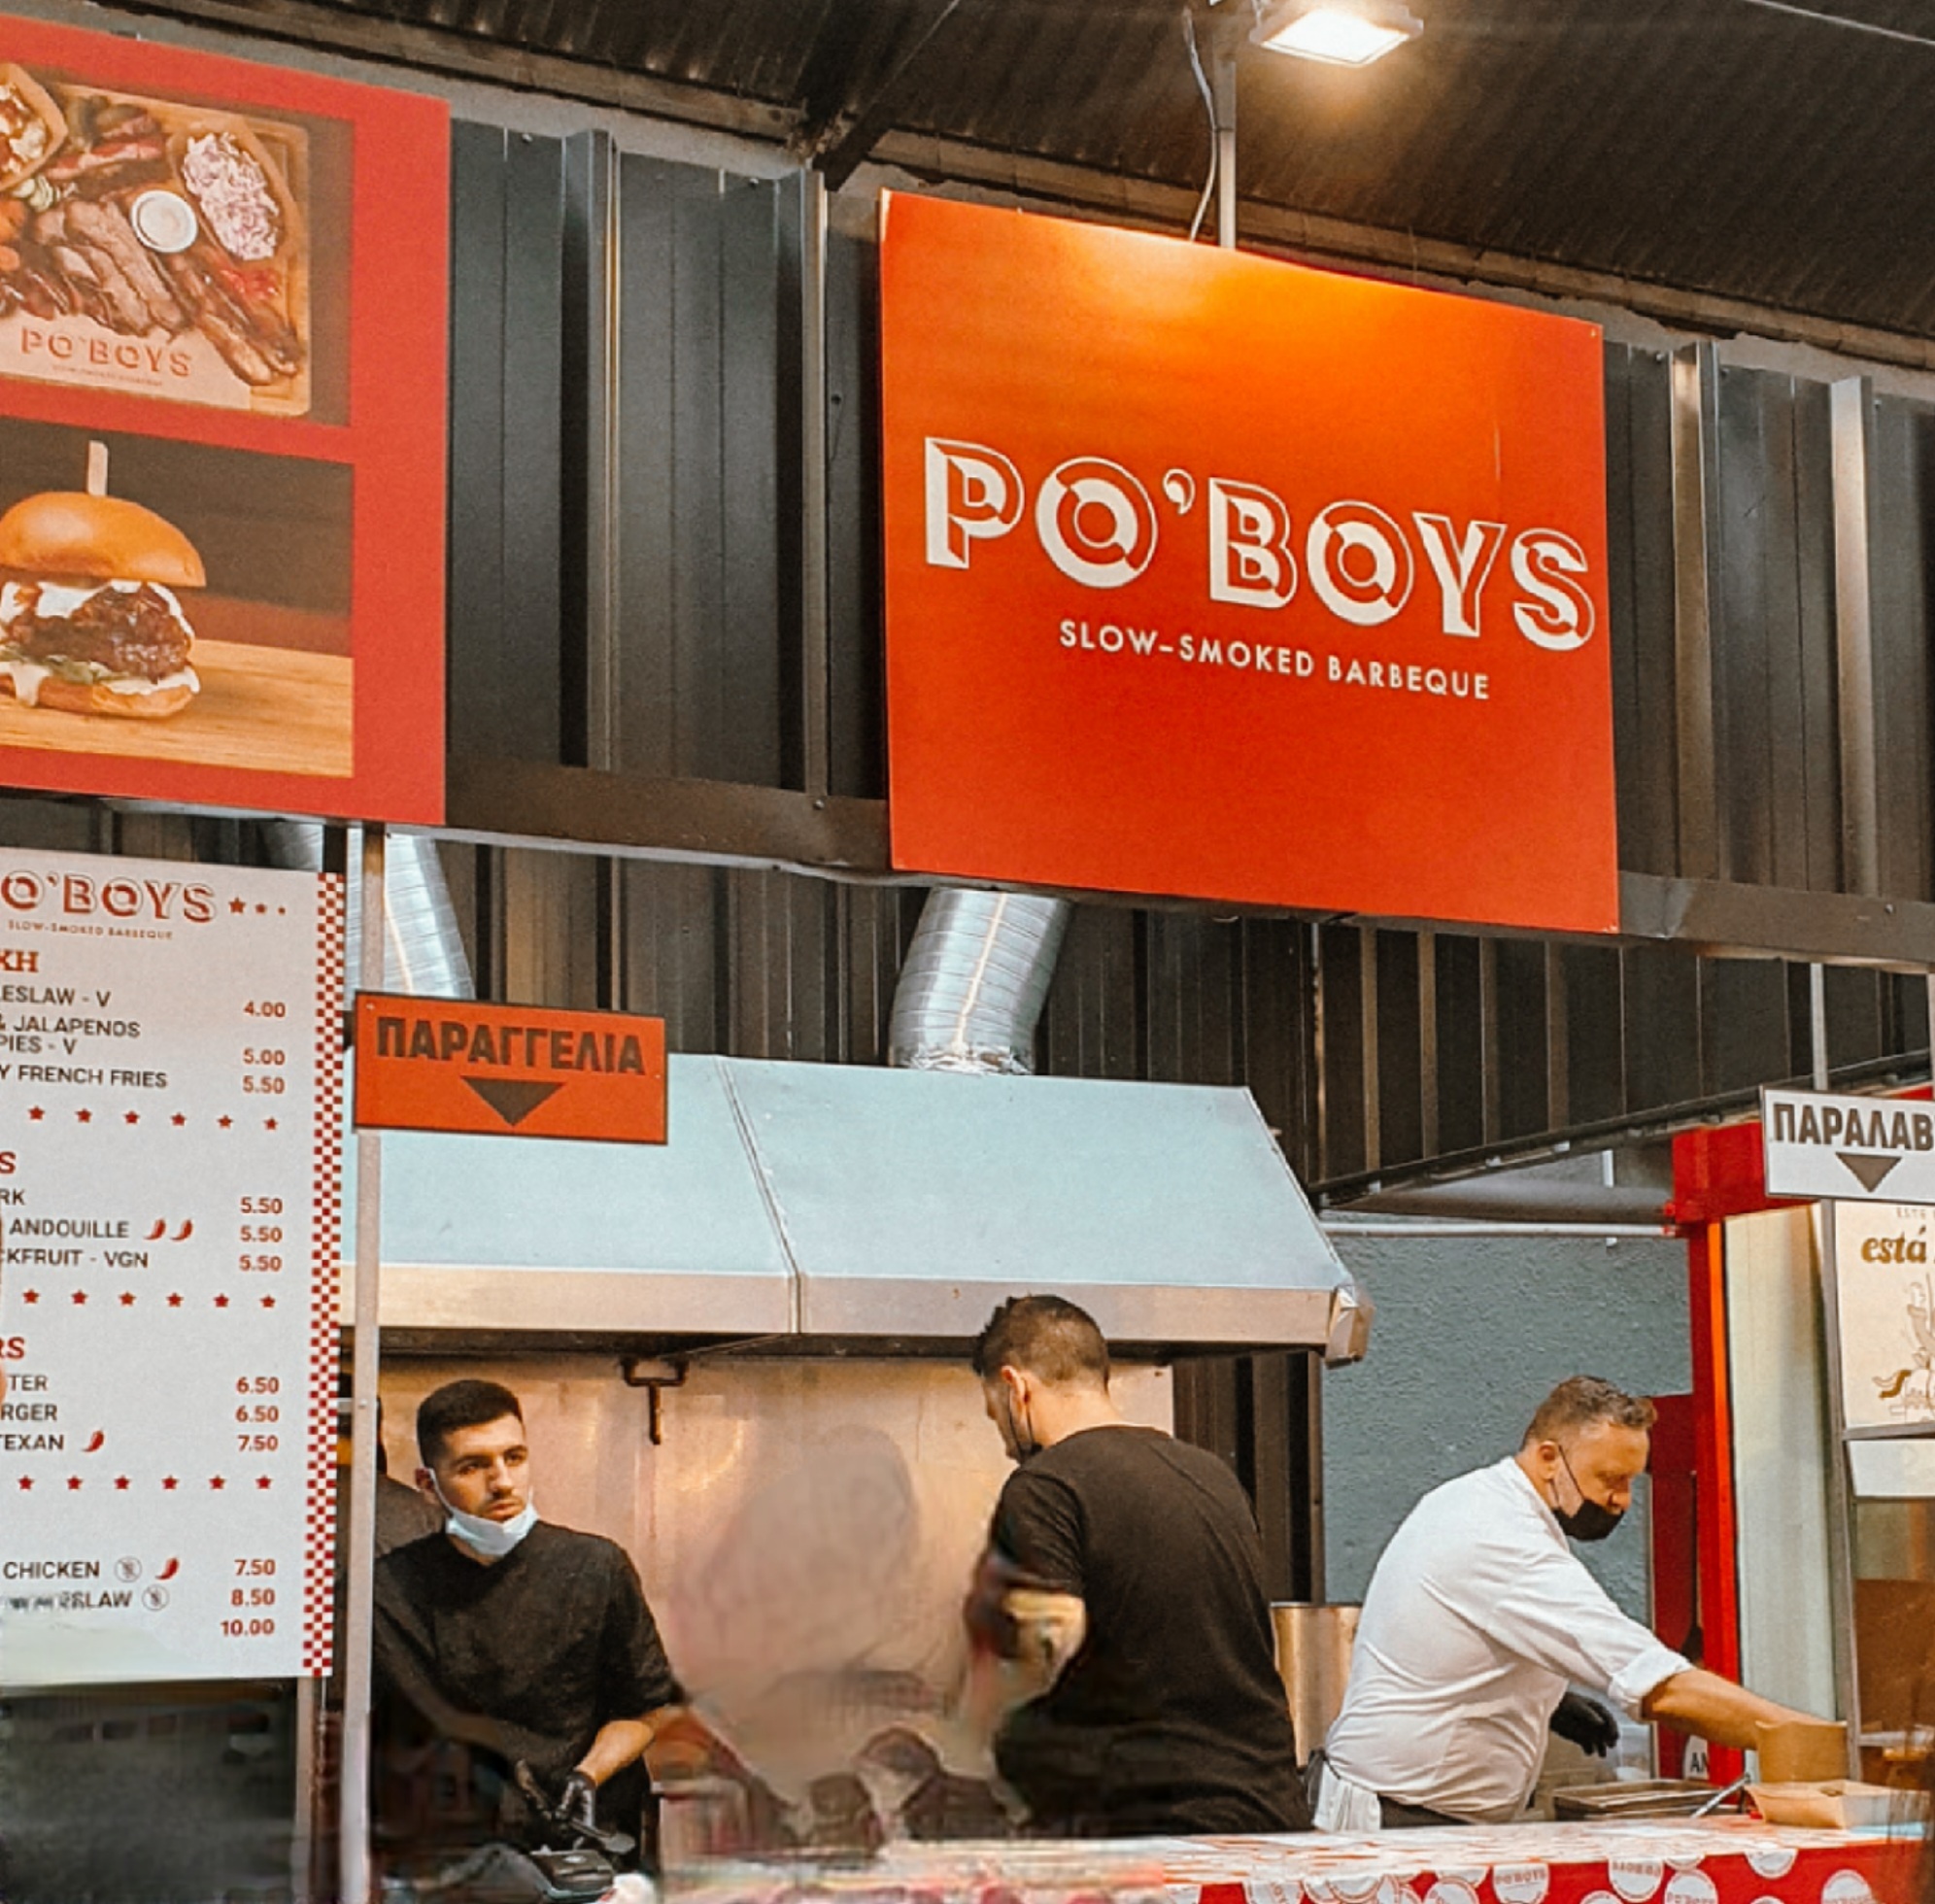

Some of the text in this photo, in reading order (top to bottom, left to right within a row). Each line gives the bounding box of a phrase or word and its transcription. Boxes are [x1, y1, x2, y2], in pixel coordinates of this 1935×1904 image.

[21, 326, 191, 377] PO'BOYS
[925, 435, 1595, 651] PO'BOYS
[1059, 619, 1490, 700] SLOW-SMOKED BARBEQUE
[0, 984, 76, 1005] ESLAW
[96, 991, 112, 1007] V
[243, 1000, 286, 1018] 4.00
[14, 1014, 141, 1038] JALAPENOS
[62, 1038, 77, 1055] V
[377, 1015, 646, 1076] ΠΑΡΑΓΓΕΛΙΑ
[243, 1048, 286, 1066] 5.00
[17, 1065, 104, 1085] FRENCH
[111, 1070, 168, 1088] FRIES
[243, 1074, 286, 1094] 5.50
[1773, 1102, 1935, 1152] ΠΑΡΑΛΑΒ
[240, 1196, 284, 1214] 5.50
[9, 1217, 130, 1239] ANDOUILLE
[240, 1225, 283, 1242] 5.50
[1861, 1225, 1927, 1264] está
[103, 1251, 149, 1268] VGN
[239, 1254, 283, 1272] 5.50
[236, 1377, 280, 1395] 6.50
[0, 1404, 58, 1422] RGER
[235, 1405, 279, 1423] 6.50
[237, 1435, 279, 1452] 7.50
[3, 1560, 100, 1580] CHICKEN
[234, 1558, 276, 1576] 7.50
[231, 1587, 276, 1607] 8.50
[221, 1618, 275, 1638] 10.00
